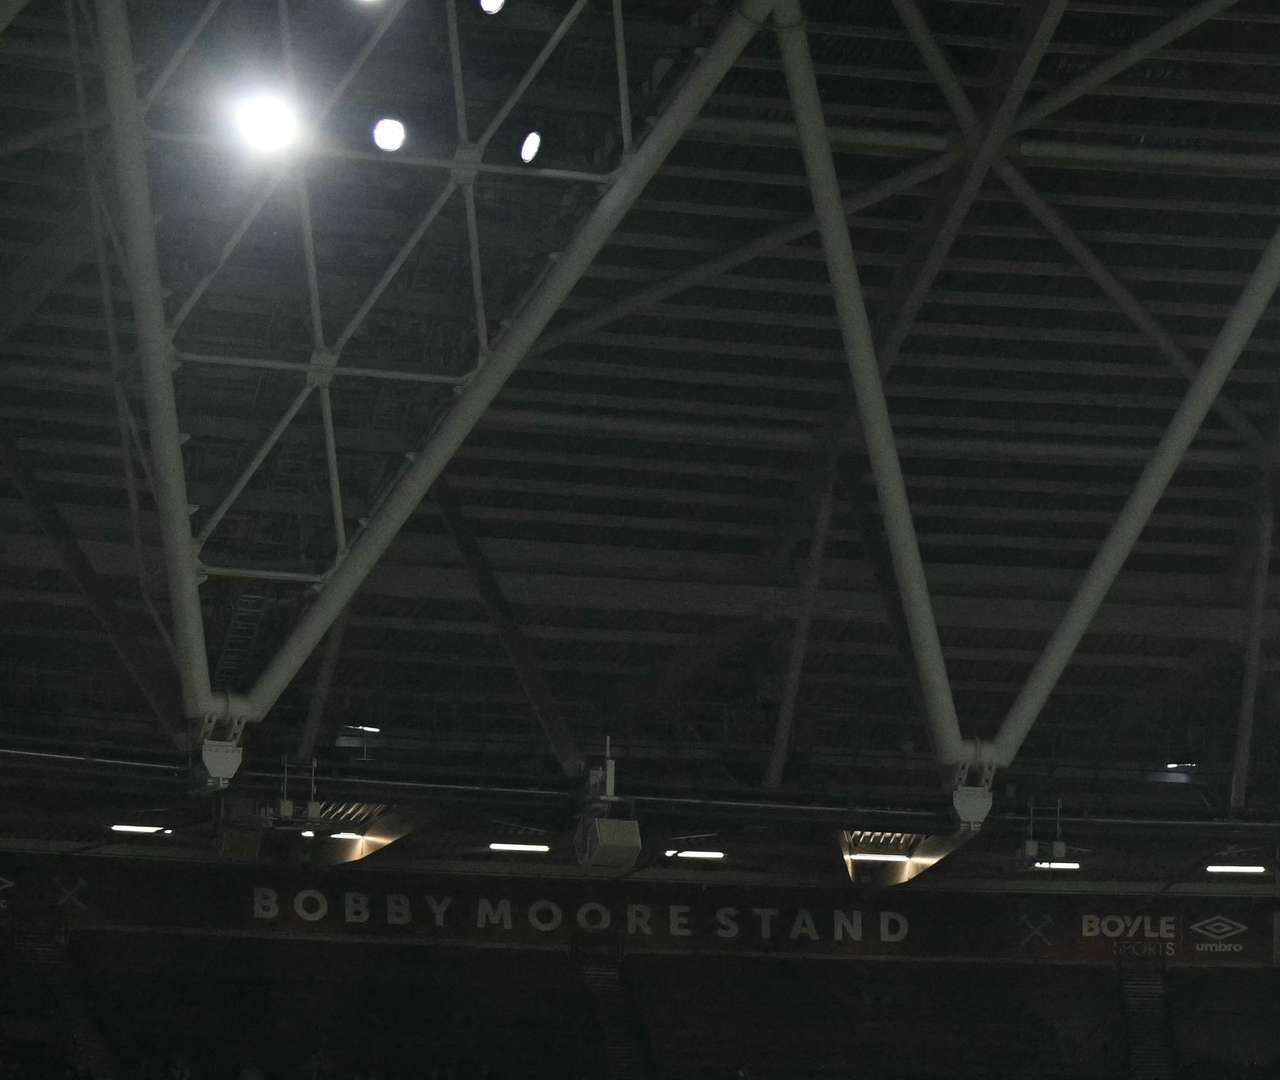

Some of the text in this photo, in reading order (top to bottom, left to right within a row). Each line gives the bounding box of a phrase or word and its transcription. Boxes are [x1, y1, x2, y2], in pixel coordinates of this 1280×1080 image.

[253, 887, 910, 943] BOBBY MOORE STAND
[1081, 914, 1175, 938] BOYLE
[1195, 942, 1243, 953] umbro
